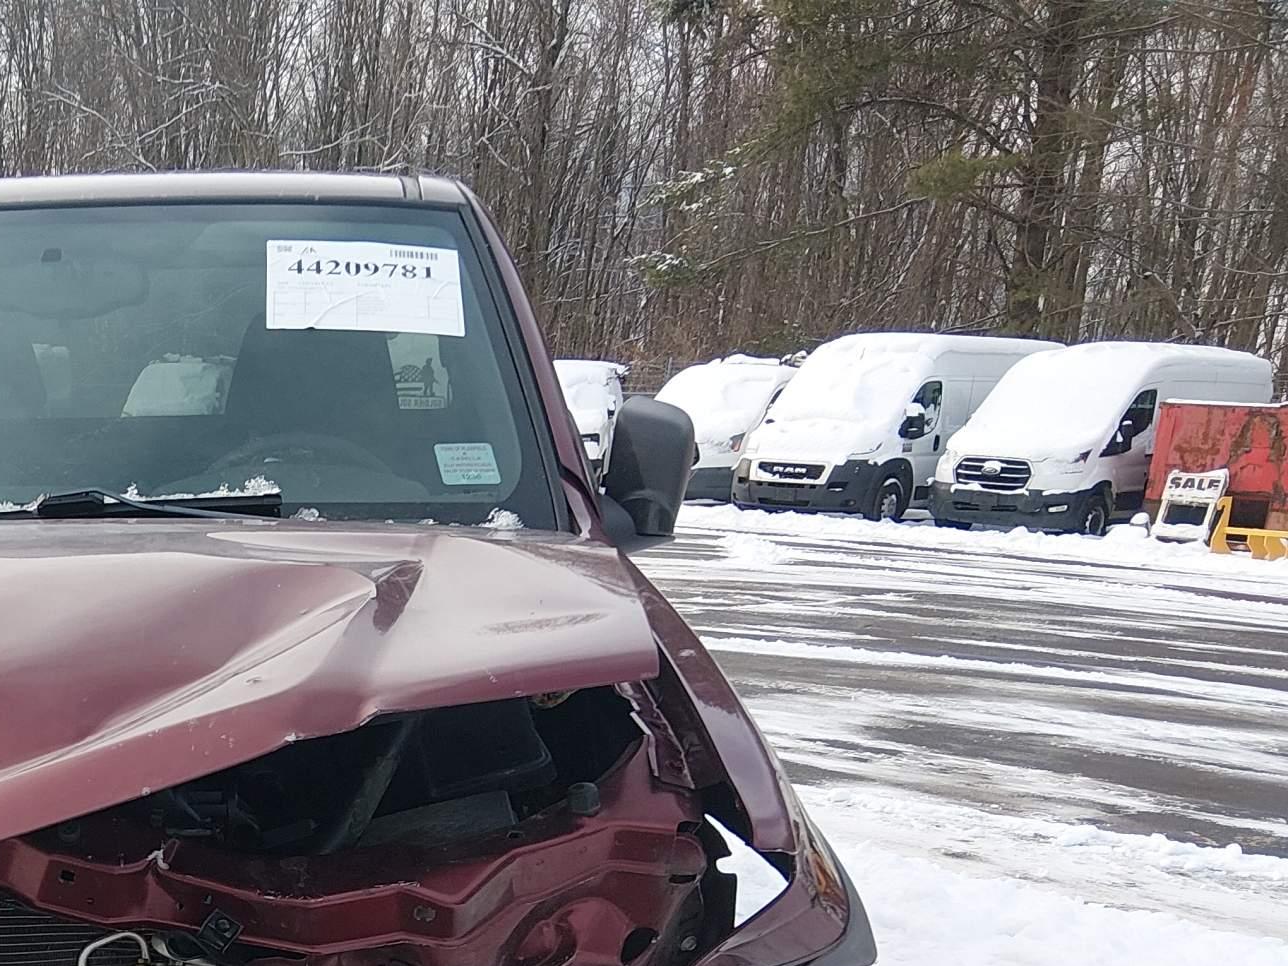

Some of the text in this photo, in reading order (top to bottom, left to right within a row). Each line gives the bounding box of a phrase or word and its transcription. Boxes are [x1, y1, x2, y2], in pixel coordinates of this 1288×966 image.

[287, 258, 432, 279] 44209781
[772, 466, 807, 474] RAM
[1168, 476, 1221, 491] SALE
